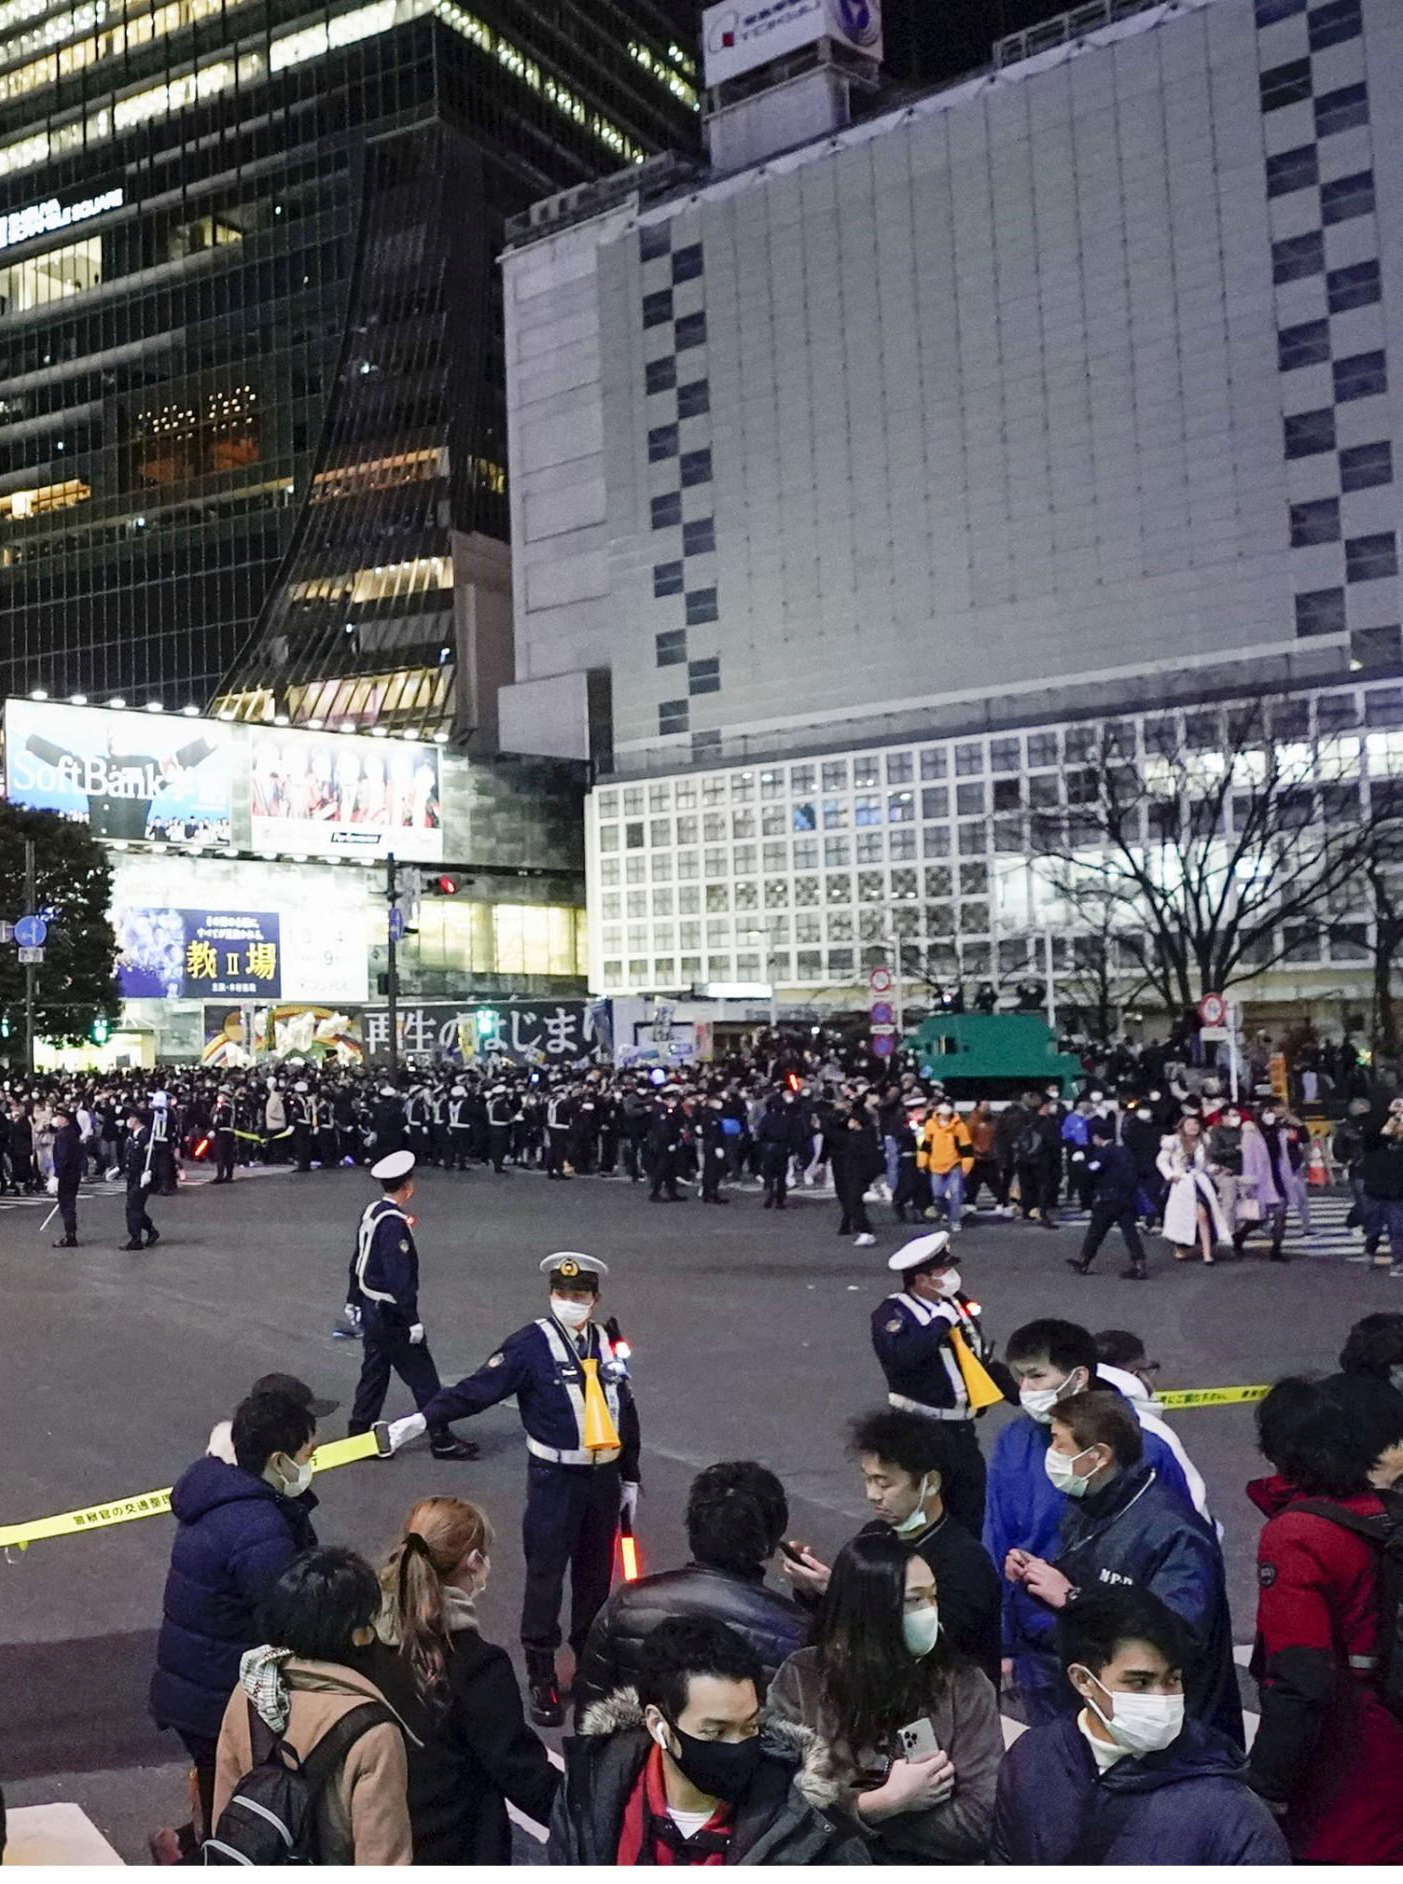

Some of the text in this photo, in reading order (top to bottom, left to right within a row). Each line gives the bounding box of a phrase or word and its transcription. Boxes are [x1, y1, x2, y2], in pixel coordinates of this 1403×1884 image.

[13, 752, 167, 800] SoftBank
[186, 940, 217, 980] 教
[246, 943, 277, 980] 場
